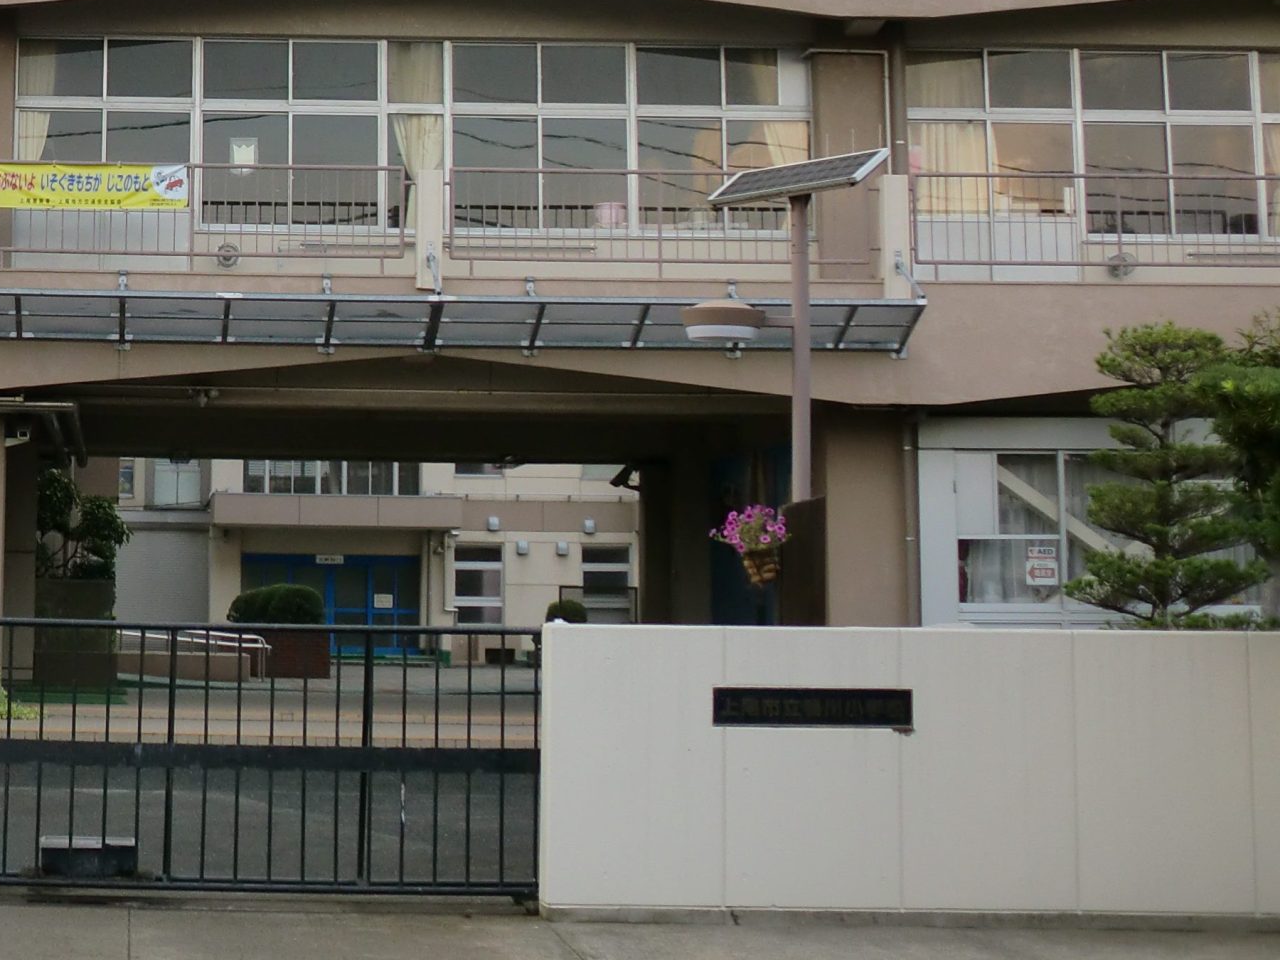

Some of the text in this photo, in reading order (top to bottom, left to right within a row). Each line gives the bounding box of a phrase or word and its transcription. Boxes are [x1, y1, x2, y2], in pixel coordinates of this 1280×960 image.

[41, 172, 102, 192] いそぐきもちが
[107, 173, 150, 192] じこのもと
